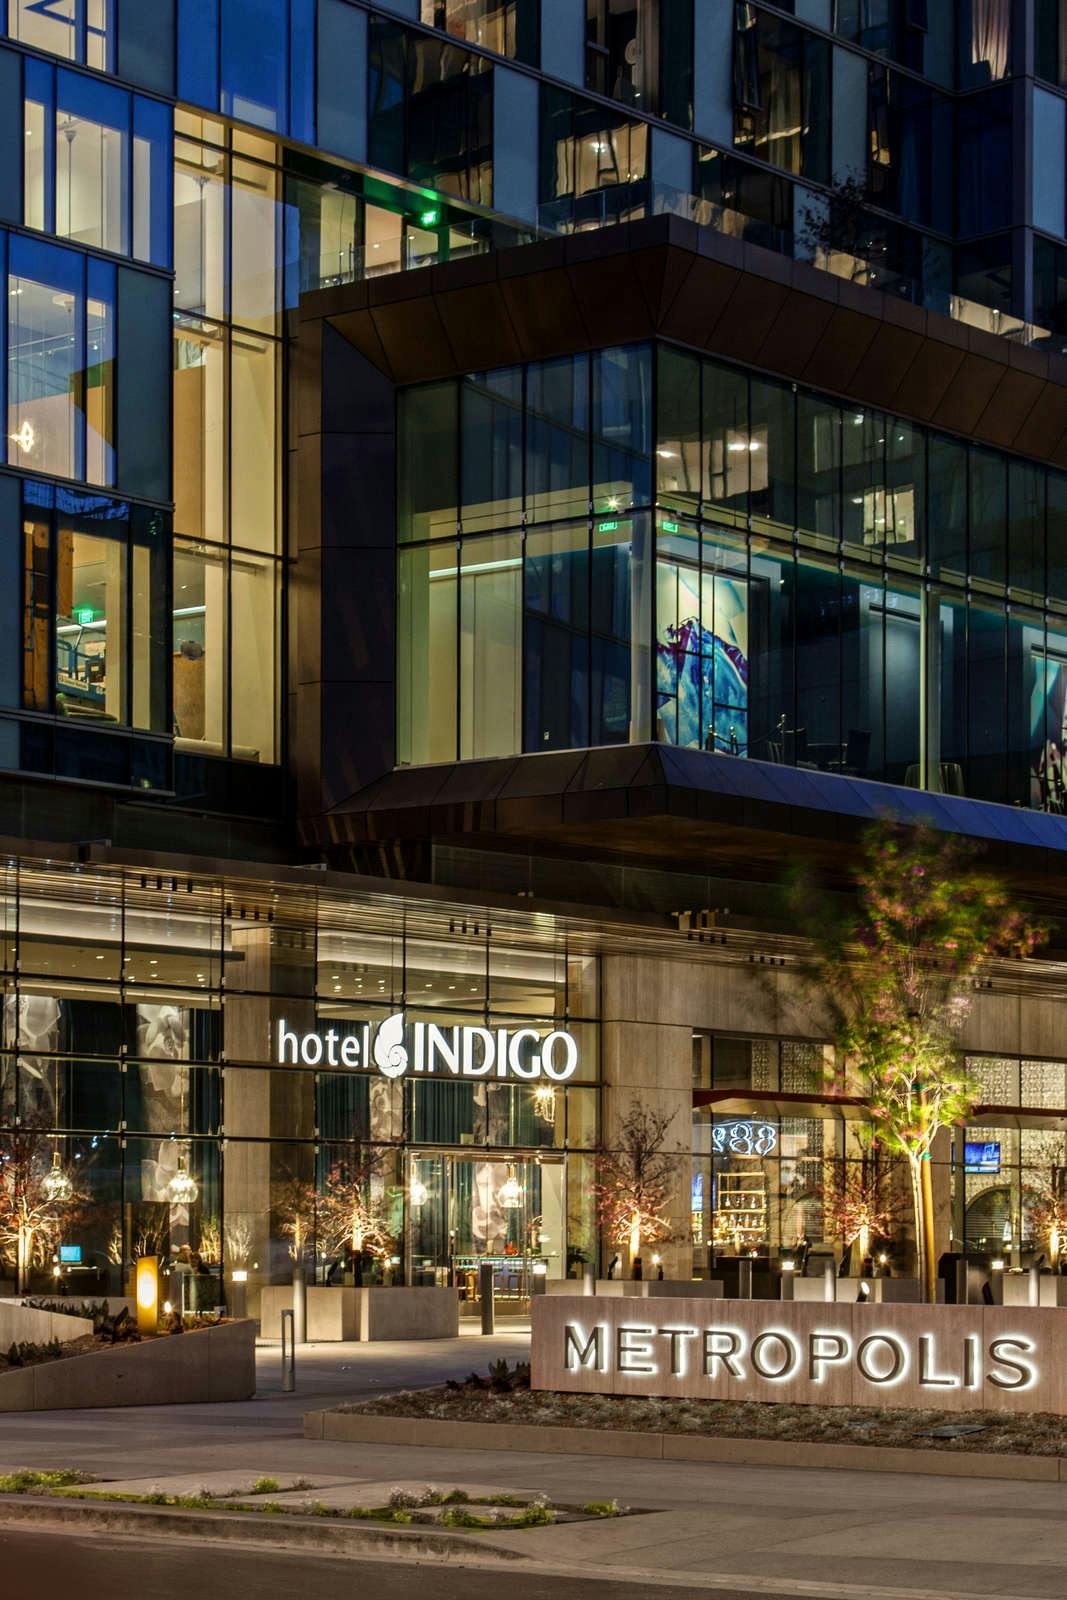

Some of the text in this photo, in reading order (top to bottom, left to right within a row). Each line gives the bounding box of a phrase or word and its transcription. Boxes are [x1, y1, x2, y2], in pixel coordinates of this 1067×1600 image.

[278, 1019, 578, 1081] hotel INDIGO
[563, 1323, 1039, 1390] METROPOLIS
